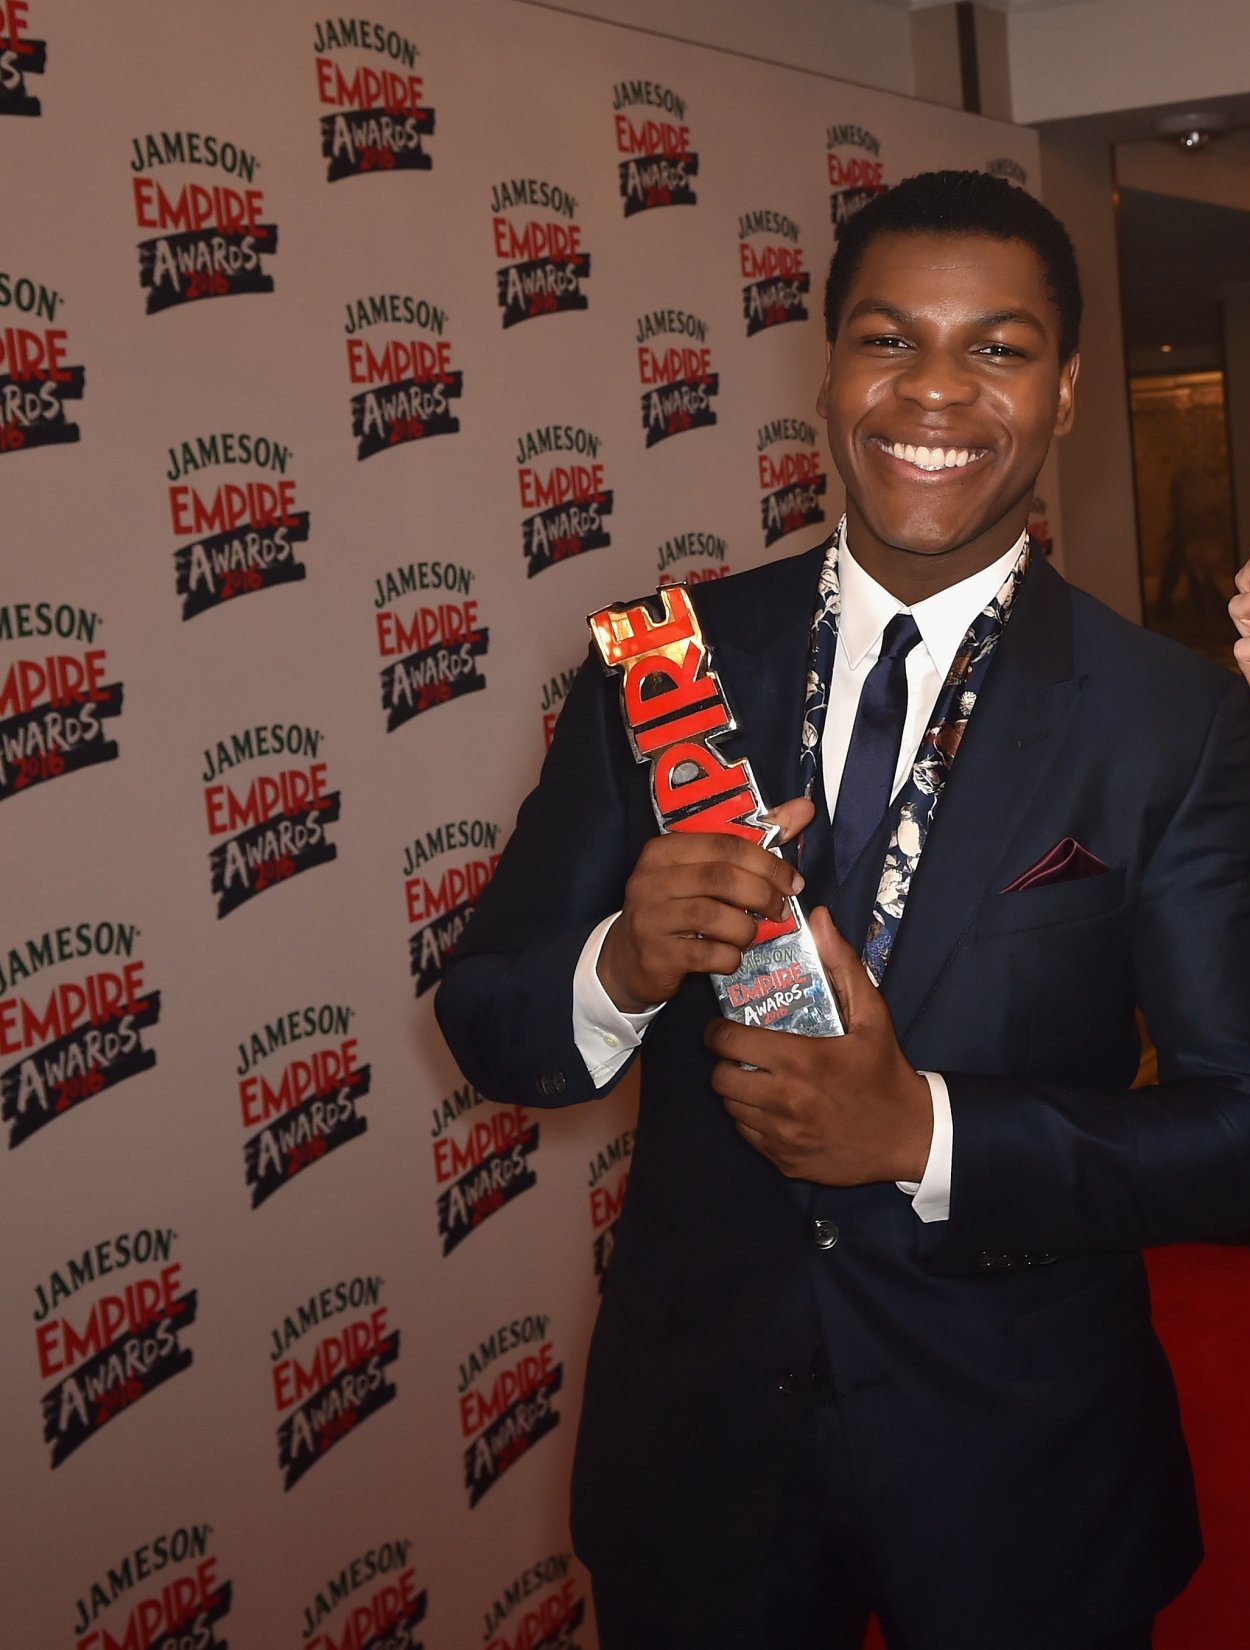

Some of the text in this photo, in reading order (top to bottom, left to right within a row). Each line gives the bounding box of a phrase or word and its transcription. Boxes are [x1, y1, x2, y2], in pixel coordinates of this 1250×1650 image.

[314, 17, 417, 69] JAMESON
[315, 56, 428, 119] EMPIRE
[612, 80, 686, 122] JAMESON
[131, 132, 255, 183] JAMESON
[333, 115, 420, 164] AWARDS
[614, 113, 693, 164] EMPIRE
[133, 178, 268, 238] EMPIRE
[491, 179, 576, 219] JAMESON
[153, 237, 258, 292] AWARDS
[492, 216, 584, 264] EMPIRE
[506, 262, 577, 310] AWARDS
[345, 295, 445, 336] JAMESON
[636, 309, 708, 343] JAMESON
[346, 338, 455, 385] EMPIRE
[637, 347, 714, 385] EMPIRE
[362, 383, 448, 438] AWARDS
[168, 434, 289, 481] JAMESON
[516, 425, 598, 464] JAMESON
[169, 482, 300, 536] EMPIRE
[517, 464, 607, 509] EMPIRE
[531, 502, 600, 558] AWARDS
[657, 532, 727, 571] JAMESON
[188, 527, 291, 593] AWARDS
[375, 562, 472, 609] JAMESON
[376, 600, 482, 657] EMPIRE
[391, 643, 475, 707] AWARDS
[0, 703, 97, 785] WARDS
[203, 725, 319, 783] JAMESON
[204, 763, 331, 835] EMPIRE
[223, 811, 322, 889] AWARDS
[403, 820, 498, 877] JAMESON
[0, 961, 148, 1057] EMPIRE
[726, 962, 806, 1008] EMPIRE
[742, 983, 802, 1025] AWARDS
[17, 1016, 138, 1112] AWARDS
[237, 1005, 350, 1075] JAMESON
[238, 1038, 362, 1127] EMPIRE
[257, 1087, 357, 1178] AWARDS
[432, 1104, 530, 1183] EMPIRE
[34, 1229, 172, 1321] JAMESON
[35, 1263, 186, 1377] EMPIRE
[270, 1277, 382, 1361] JAMESON
[60, 1319, 176, 1430] AWARDS
[271, 1308, 388, 1412] EMPIRE
[458, 1315, 549, 1393] JAMESON
[459, 1342, 556, 1438] EMPIRE
[75, 1525, 211, 1635] JAMESON
[301, 1541, 408, 1639] JAMESON
